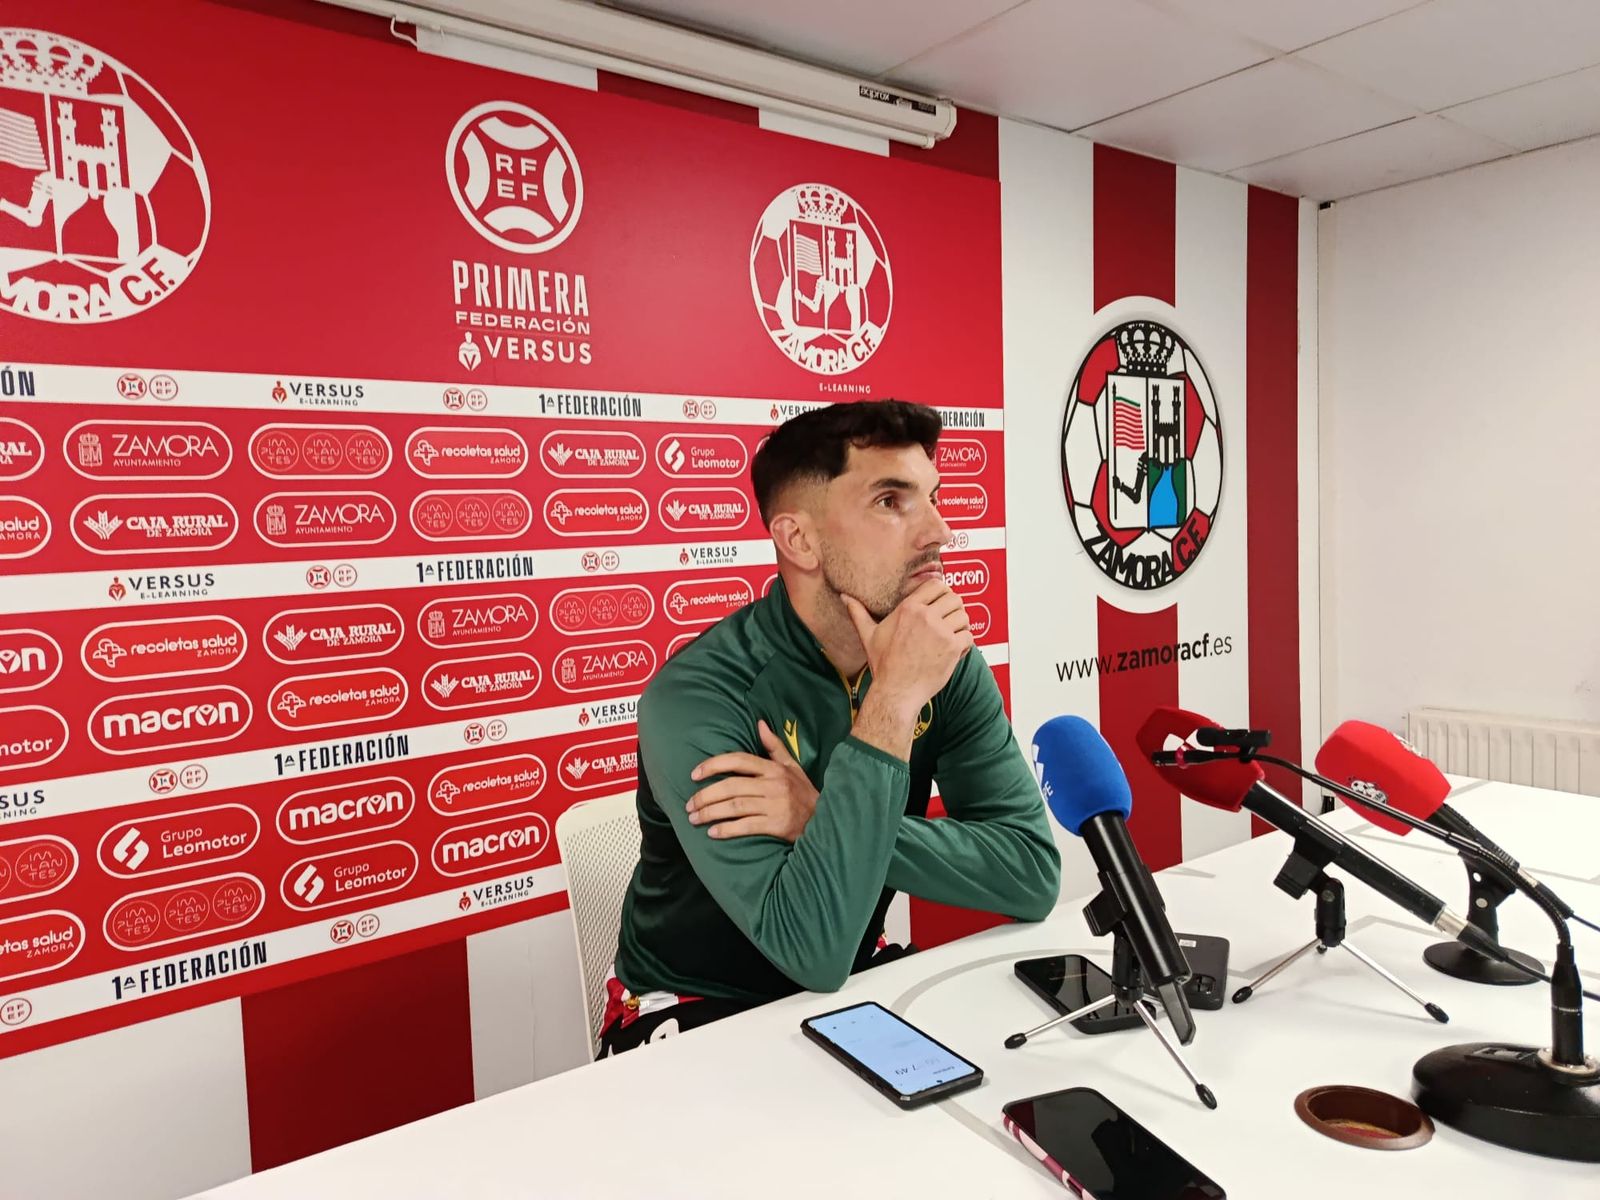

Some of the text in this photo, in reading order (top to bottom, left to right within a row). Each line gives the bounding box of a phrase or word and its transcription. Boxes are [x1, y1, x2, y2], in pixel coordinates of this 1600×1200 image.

[120, 258, 175, 305] C.F.
[452, 260, 589, 316] PRIMERA
[455, 311, 590, 335] FEDERACIÓN
[484, 335, 592, 365] VERSUS
[771, 328, 848, 372] ZAMORA
[289, 382, 364, 398] VERSUS
[819, 382, 871, 393] E-LEARNING
[300, 398, 358, 406] E-LEARNING
[557, 394, 641, 417] FEDERACIÓN
[939, 410, 984, 427] DERACIÓN
[112, 434, 218, 457] ZAMORA
[441, 445, 520, 457] recoletas salud
[575, 448, 639, 460] CAJA RURAL
[691, 446, 715, 457] Grupo
[940, 447, 981, 461] ZAMORA
[113, 459, 181, 467] AYUNTAMIENTO
[600, 458, 629, 466] ZAMORA
[692, 458, 740, 469] Leomotor
[294, 504, 385, 525] ZAMORA
[574, 504, 642, 516] recoletas salud
[689, 503, 744, 514] CAJA RURAL
[126, 515, 228, 529] CAJA RURAL
[295, 526, 352, 534] AYUNTAMIENTO
[146, 527, 212, 537] DE ZAMORA
[690, 546, 737, 558] VERSUS
[1084, 522, 1176, 588] ZAMORA
[437, 554, 533, 581] FEDERACIÓN
[128, 573, 215, 590] VERSUS
[140, 588, 208, 599] E-LEARNING
[690, 591, 749, 605] recoletas salud
[452, 605, 528, 628] ZAMORA
[310, 623, 395, 641] CAJA RURAL
[452, 626, 501, 637] AYUNTAMIENTO
[131, 633, 237, 655] recoletas salud
[327, 635, 382, 647] DE ZAMORA
[197, 647, 238, 657] ZAMORA
[1056, 632, 1232, 682] www.zamoracf.es
[582, 650, 648, 673] ZAMORA
[461, 670, 534, 688] CAJA RURAL
[582, 671, 624, 681] AYUNTAMIENTO
[310, 683, 400, 706] recoletas salud
[489, 681, 523, 691] ZAMORA
[365, 696, 400, 707] ZAMORA
[591, 702, 636, 718] VERSU
[103, 701, 239, 739] macron
[598, 714, 637, 724] E-LEARNIN
[299, 733, 409, 772] FEDERACIÓN
[592, 757, 617, 769] CAJA
[463, 768, 540, 792] recoletas salud
[510, 780, 540, 790] ZAMORA
[289, 791, 403, 830] macron
[160, 827, 202, 844] Grupo
[162, 832, 247, 859] Leomotor
[443, 826, 540, 864] macron
[333, 863, 369, 878] Grupo
[335, 866, 407, 892] Leomotor
[473, 876, 534, 900] VERSUS
[480, 890, 529, 907] E-LEARNING
[32, 926, 74, 946] salud
[26, 942, 75, 959] ZAMORA
[140, 940, 267, 993] FEDERACIÓN
